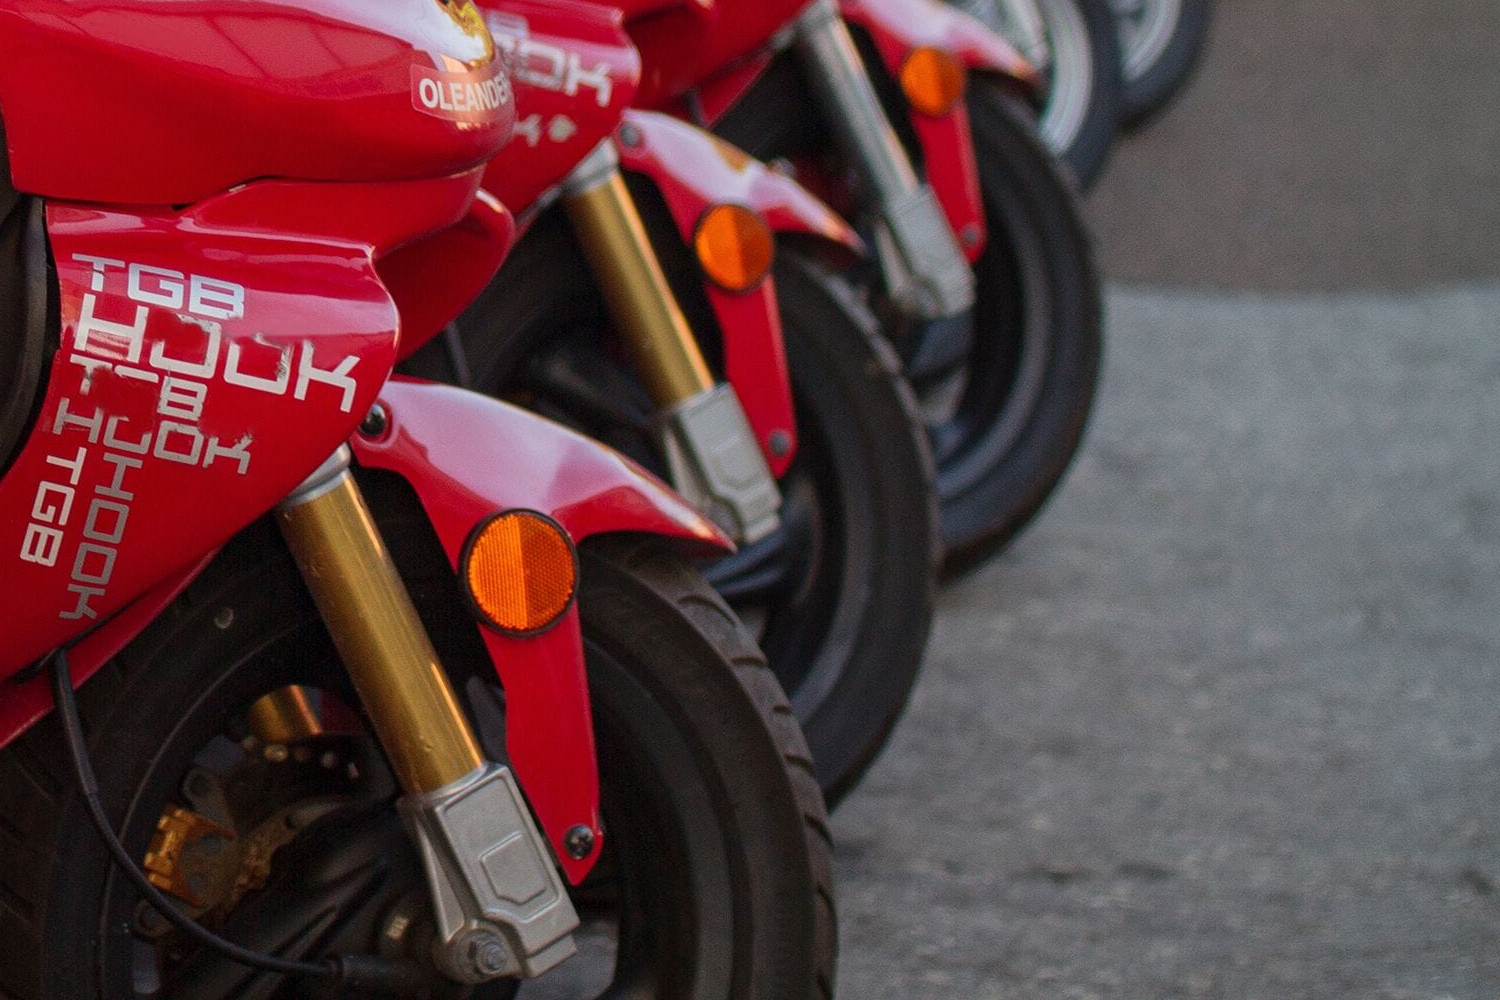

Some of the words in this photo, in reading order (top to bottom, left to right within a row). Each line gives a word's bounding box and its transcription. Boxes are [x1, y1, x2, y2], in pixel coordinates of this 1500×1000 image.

[72, 253, 245, 320] TGB
[70, 353, 208, 421] TB
[20, 446, 87, 567] TGB
[59, 452, 143, 620] HOOK
